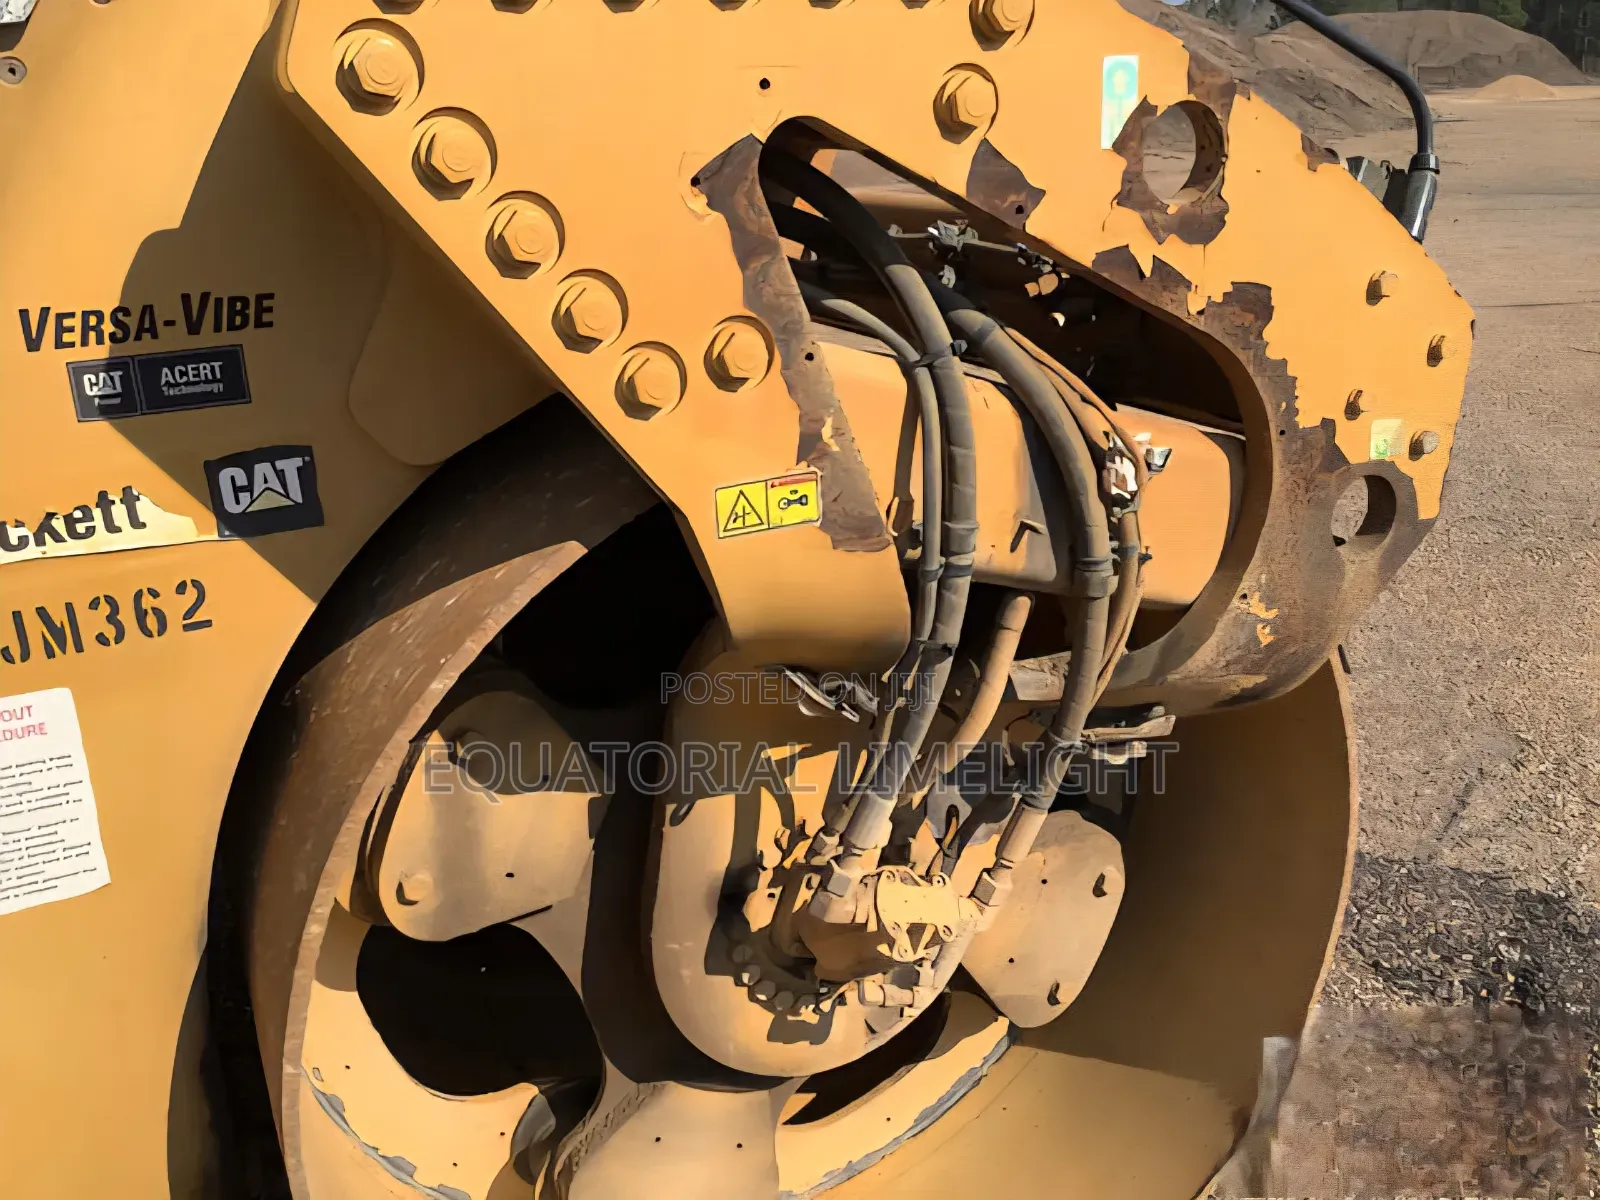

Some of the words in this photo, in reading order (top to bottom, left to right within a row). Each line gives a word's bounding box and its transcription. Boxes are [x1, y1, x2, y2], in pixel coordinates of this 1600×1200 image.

[18, 291, 276, 352] VERSA-VIBE
[83, 371, 123, 396] CAT
[160, 361, 223, 386] ACERT
[218, 456, 305, 514] CAT
[0, 579, 213, 665] JM362
[0, 722, 48, 742] DURE
